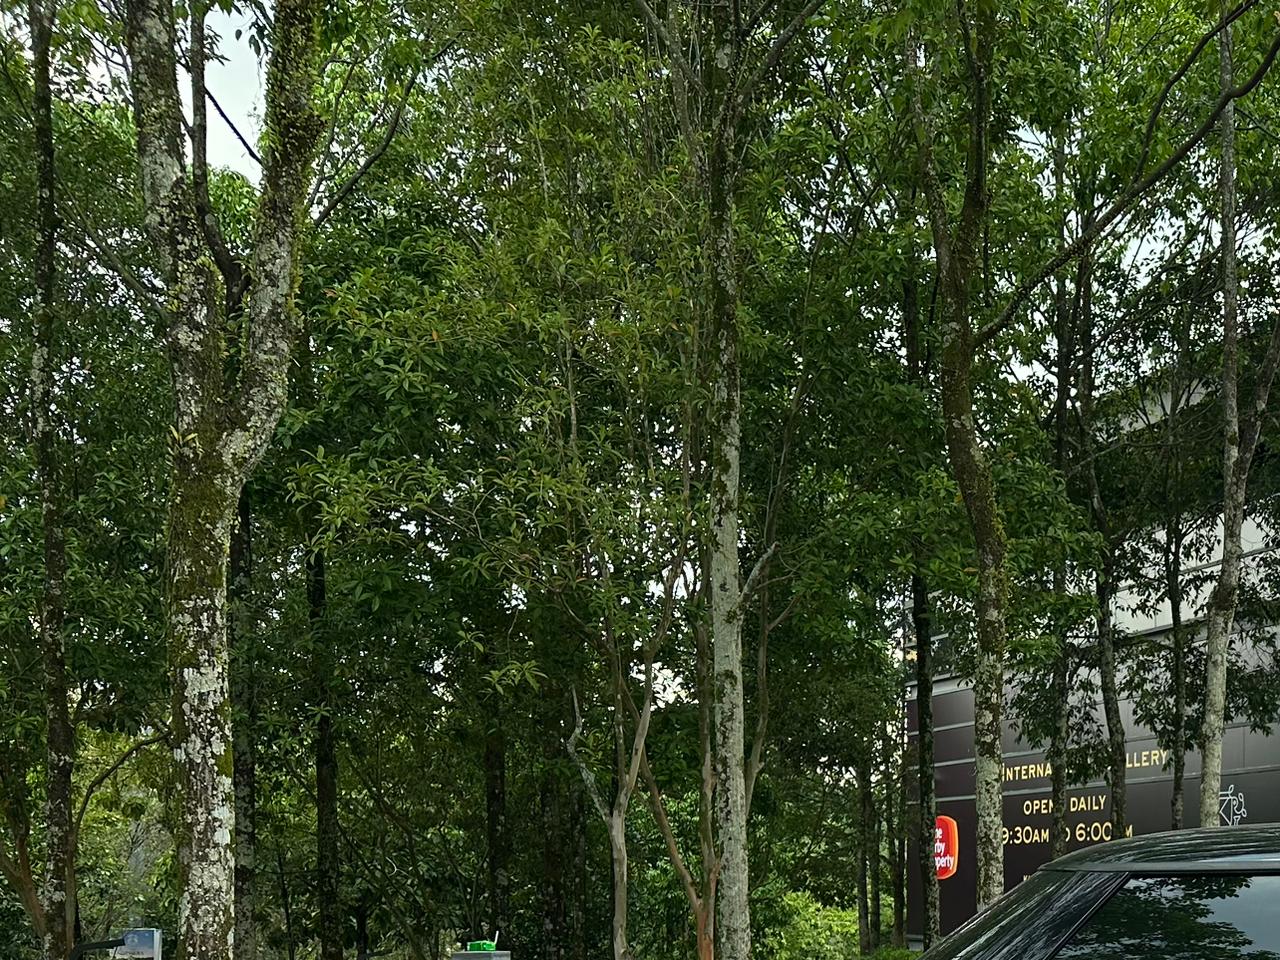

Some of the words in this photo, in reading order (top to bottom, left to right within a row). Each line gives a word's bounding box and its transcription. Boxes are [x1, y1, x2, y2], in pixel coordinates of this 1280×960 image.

[1070, 795, 1107, 812] DAILY
[1002, 826, 1049, 844] 9:30AM
[1075, 822, 1133, 841] 6:00M
